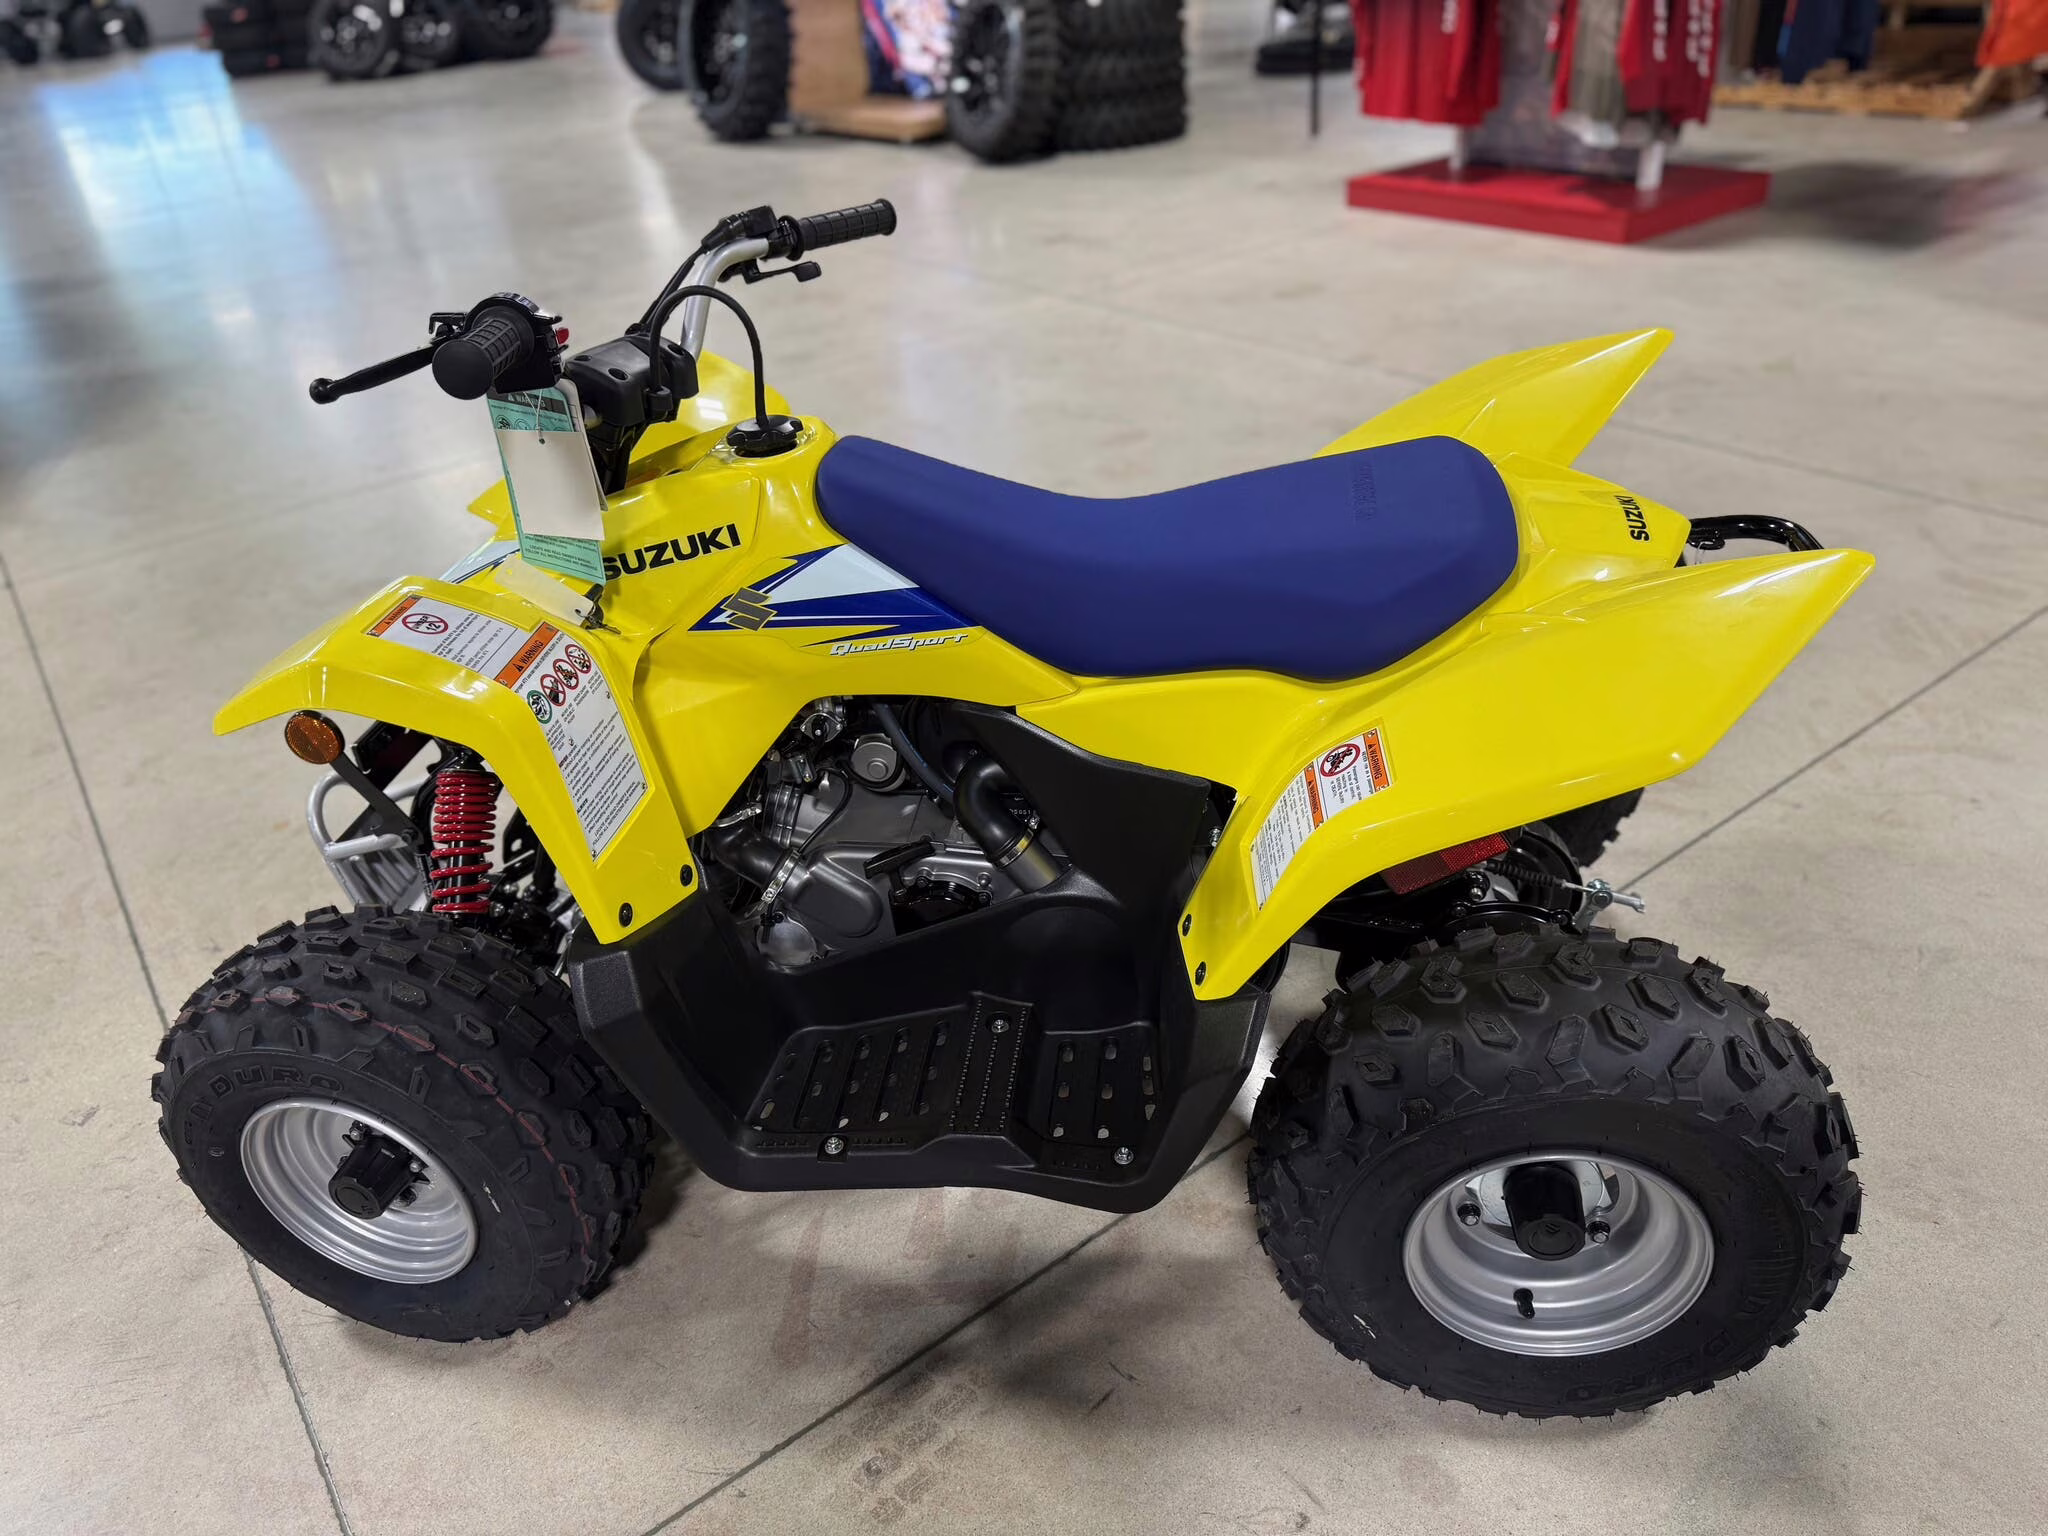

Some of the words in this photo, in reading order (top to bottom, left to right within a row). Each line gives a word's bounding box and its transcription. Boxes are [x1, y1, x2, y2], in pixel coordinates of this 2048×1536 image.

[1613, 494, 1650, 541] SUZUKI
[602, 523, 742, 581] SUZUKI
[519, 638, 543, 664] WARNING
[830, 633, 968, 656] QuadSport
[1368, 748, 1381, 779] WARNING
[208, 1064, 344, 1098] DURO
